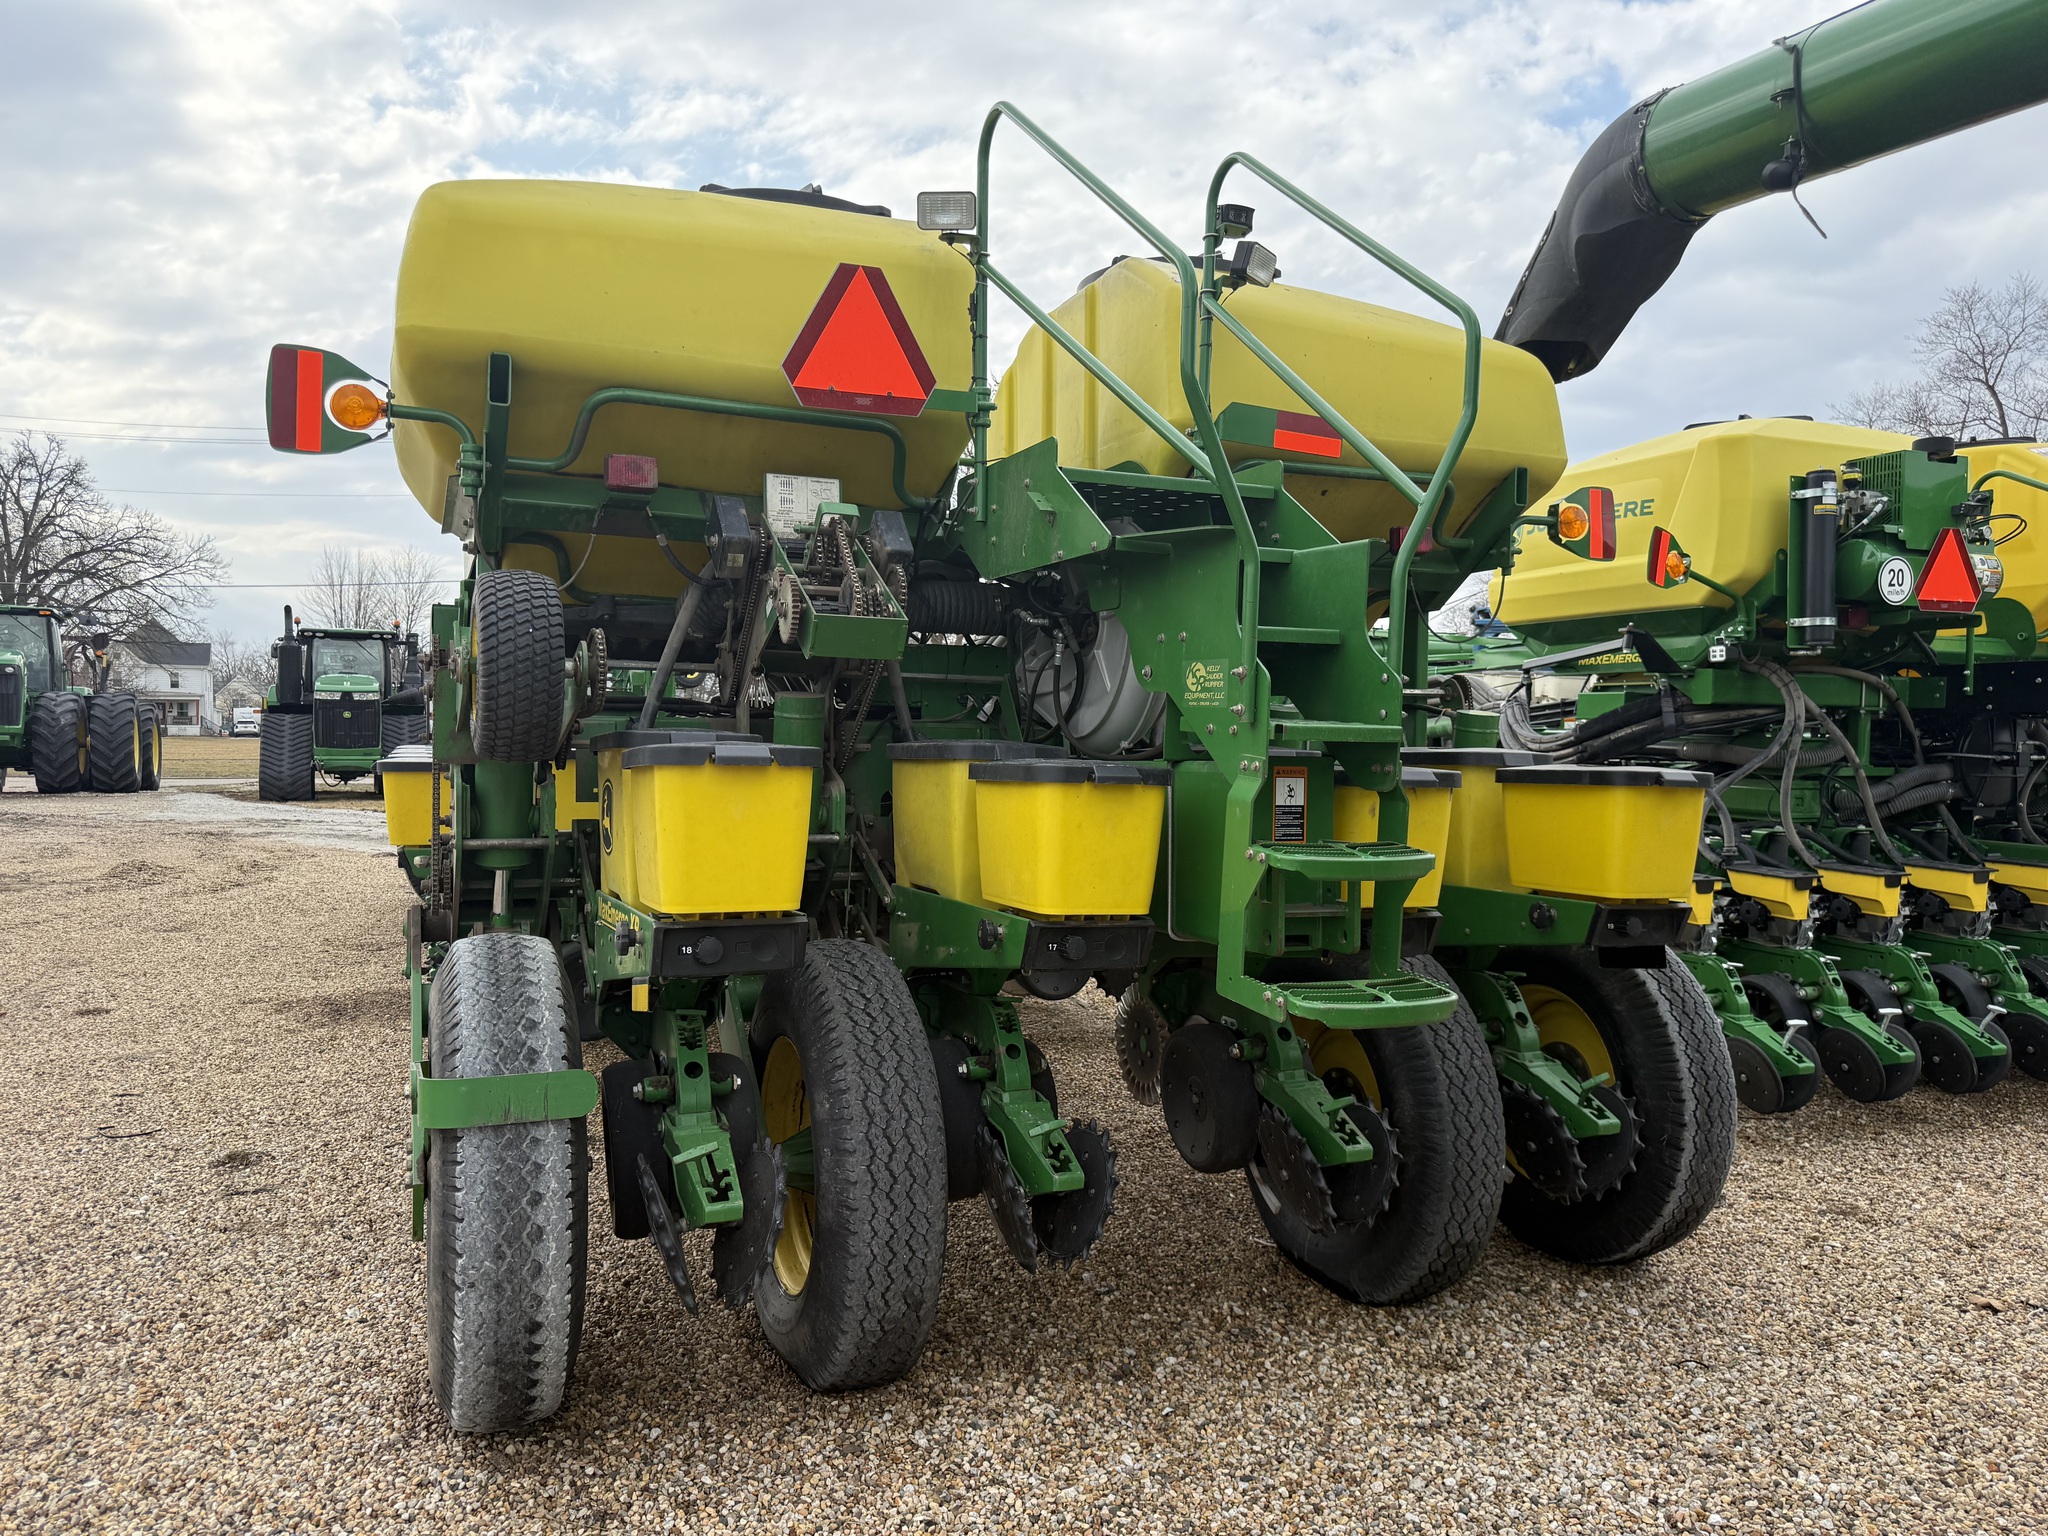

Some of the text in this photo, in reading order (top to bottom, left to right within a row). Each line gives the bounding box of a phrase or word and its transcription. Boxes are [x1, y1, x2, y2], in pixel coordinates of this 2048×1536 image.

[1615, 499, 1655, 519] ERE
[1888, 568, 1905, 587] 20
[1578, 653, 1642, 666] MAXEMERG
[681, 946, 693, 954] 18
